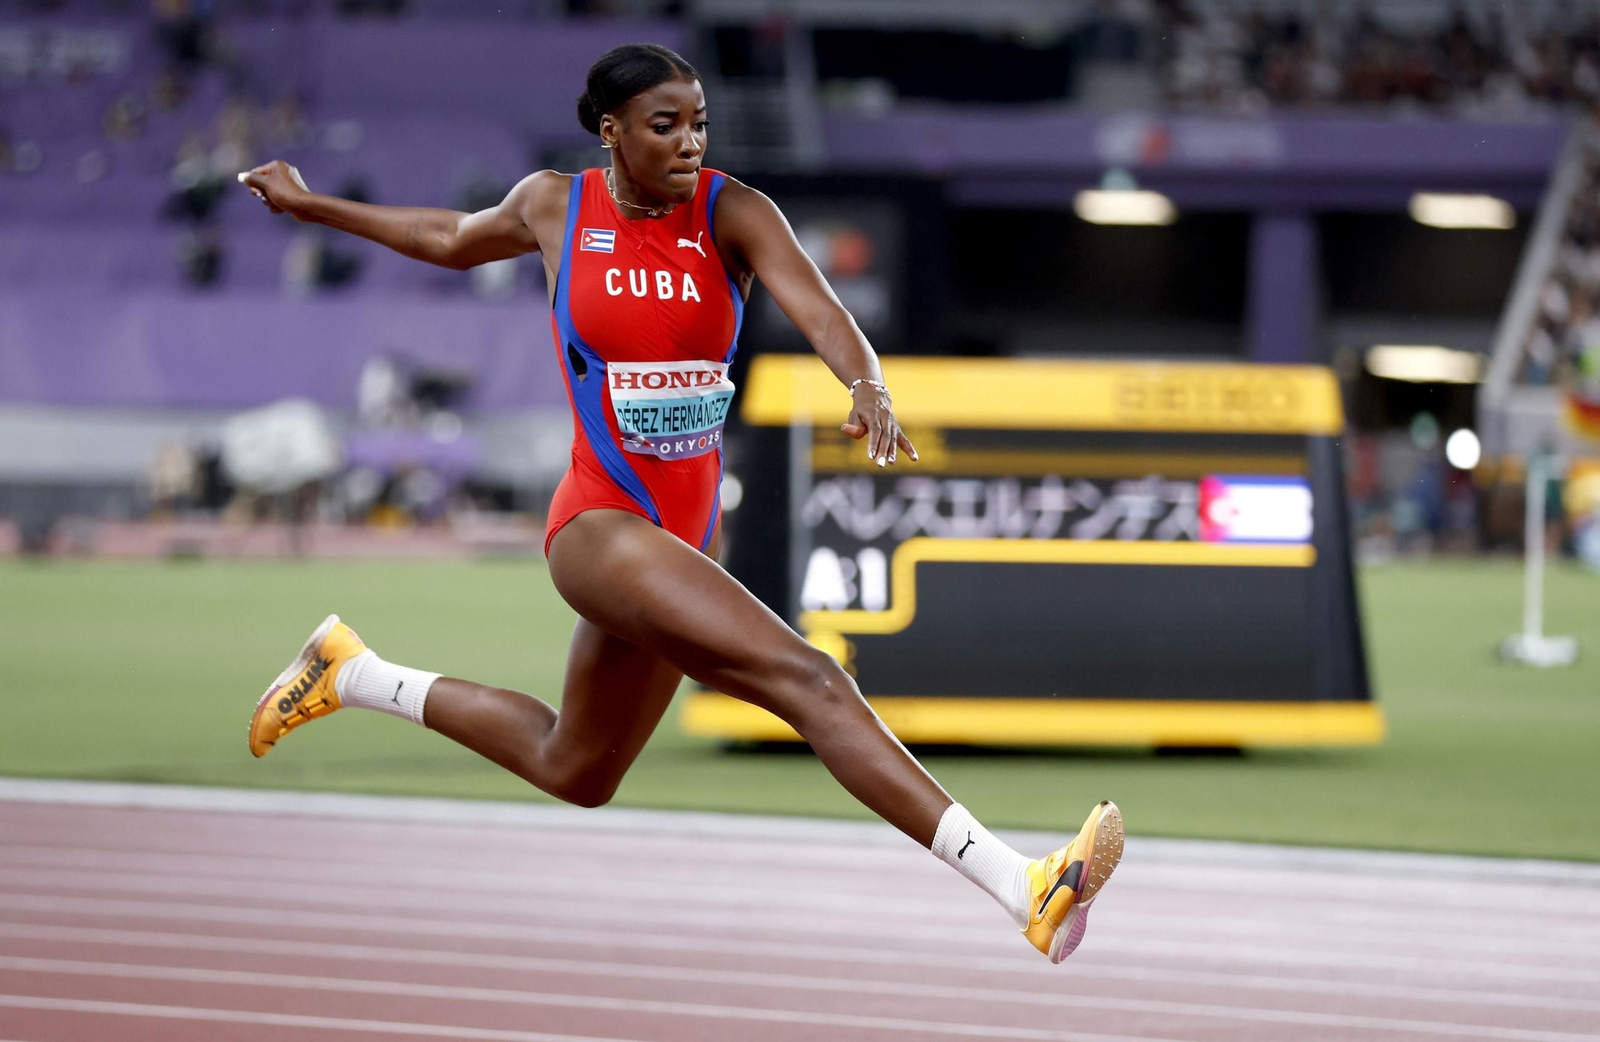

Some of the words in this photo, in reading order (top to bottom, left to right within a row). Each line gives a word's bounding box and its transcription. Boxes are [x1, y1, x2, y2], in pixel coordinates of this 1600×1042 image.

[605, 268, 701, 302] CUBA
[662, 397, 728, 432] HERNÁNDEZ
[278, 655, 332, 713] NITRO
